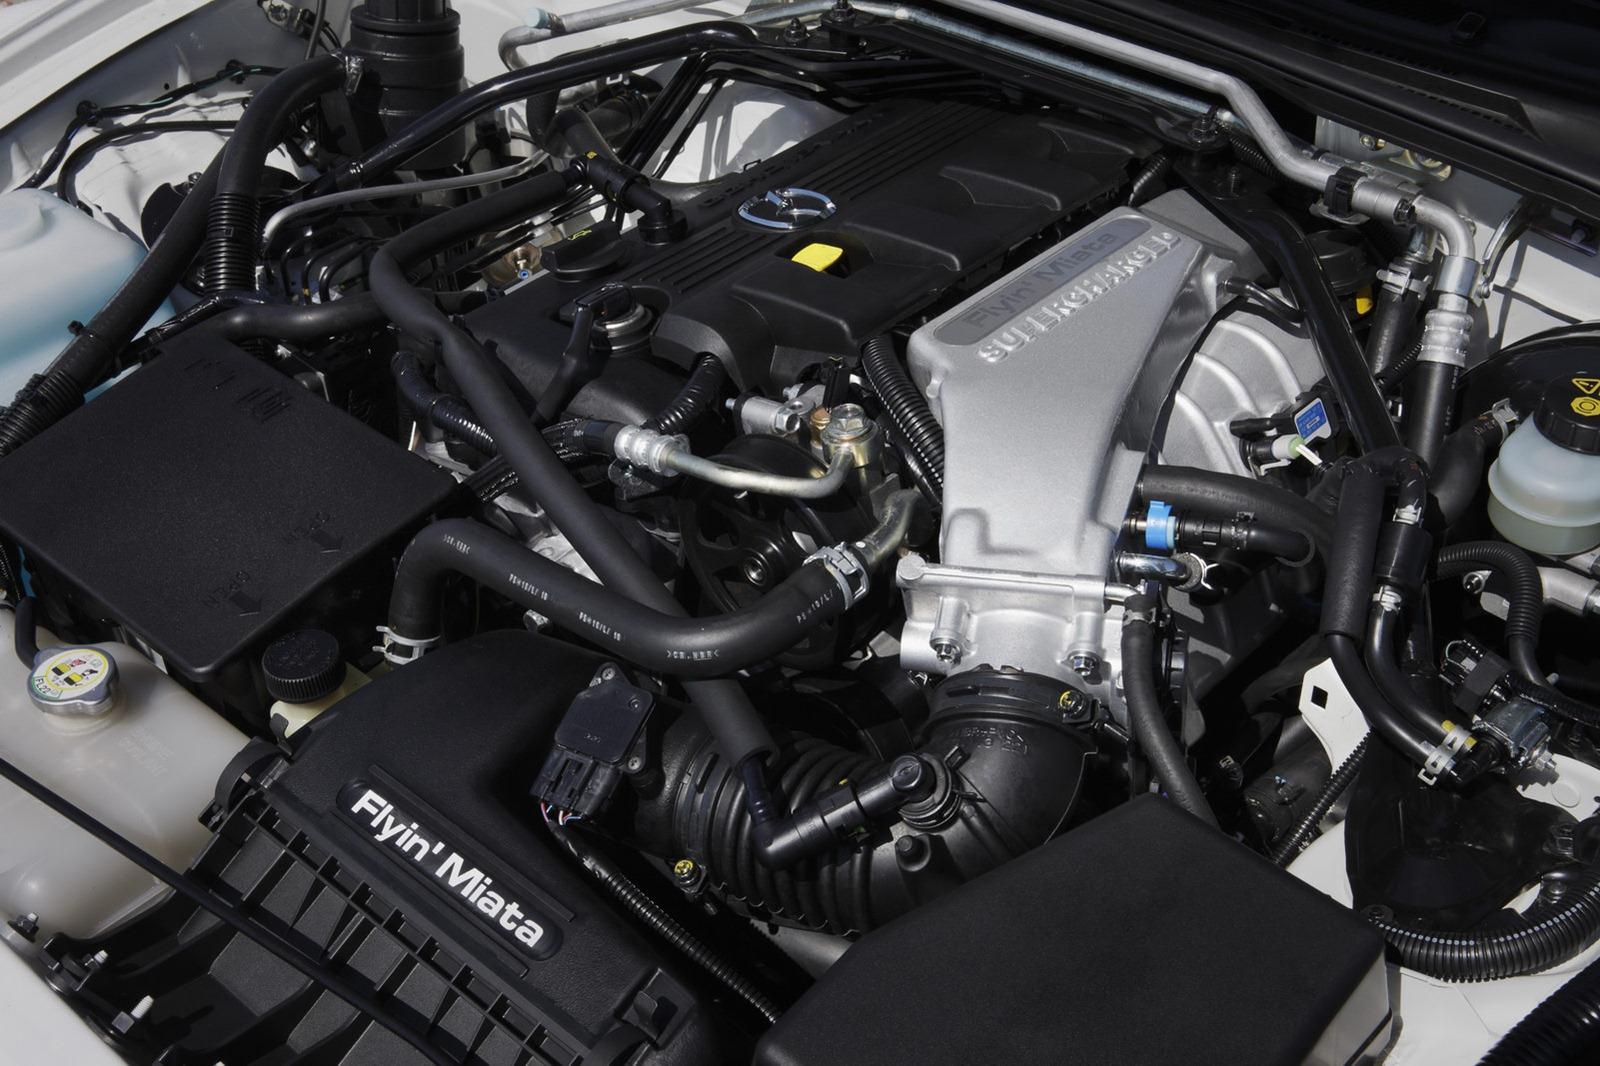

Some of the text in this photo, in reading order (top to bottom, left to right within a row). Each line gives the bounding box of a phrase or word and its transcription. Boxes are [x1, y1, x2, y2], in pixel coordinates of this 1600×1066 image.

[962, 232, 1118, 329] Flyin' Miata
[350, 788, 545, 949] Flyin' Miata
